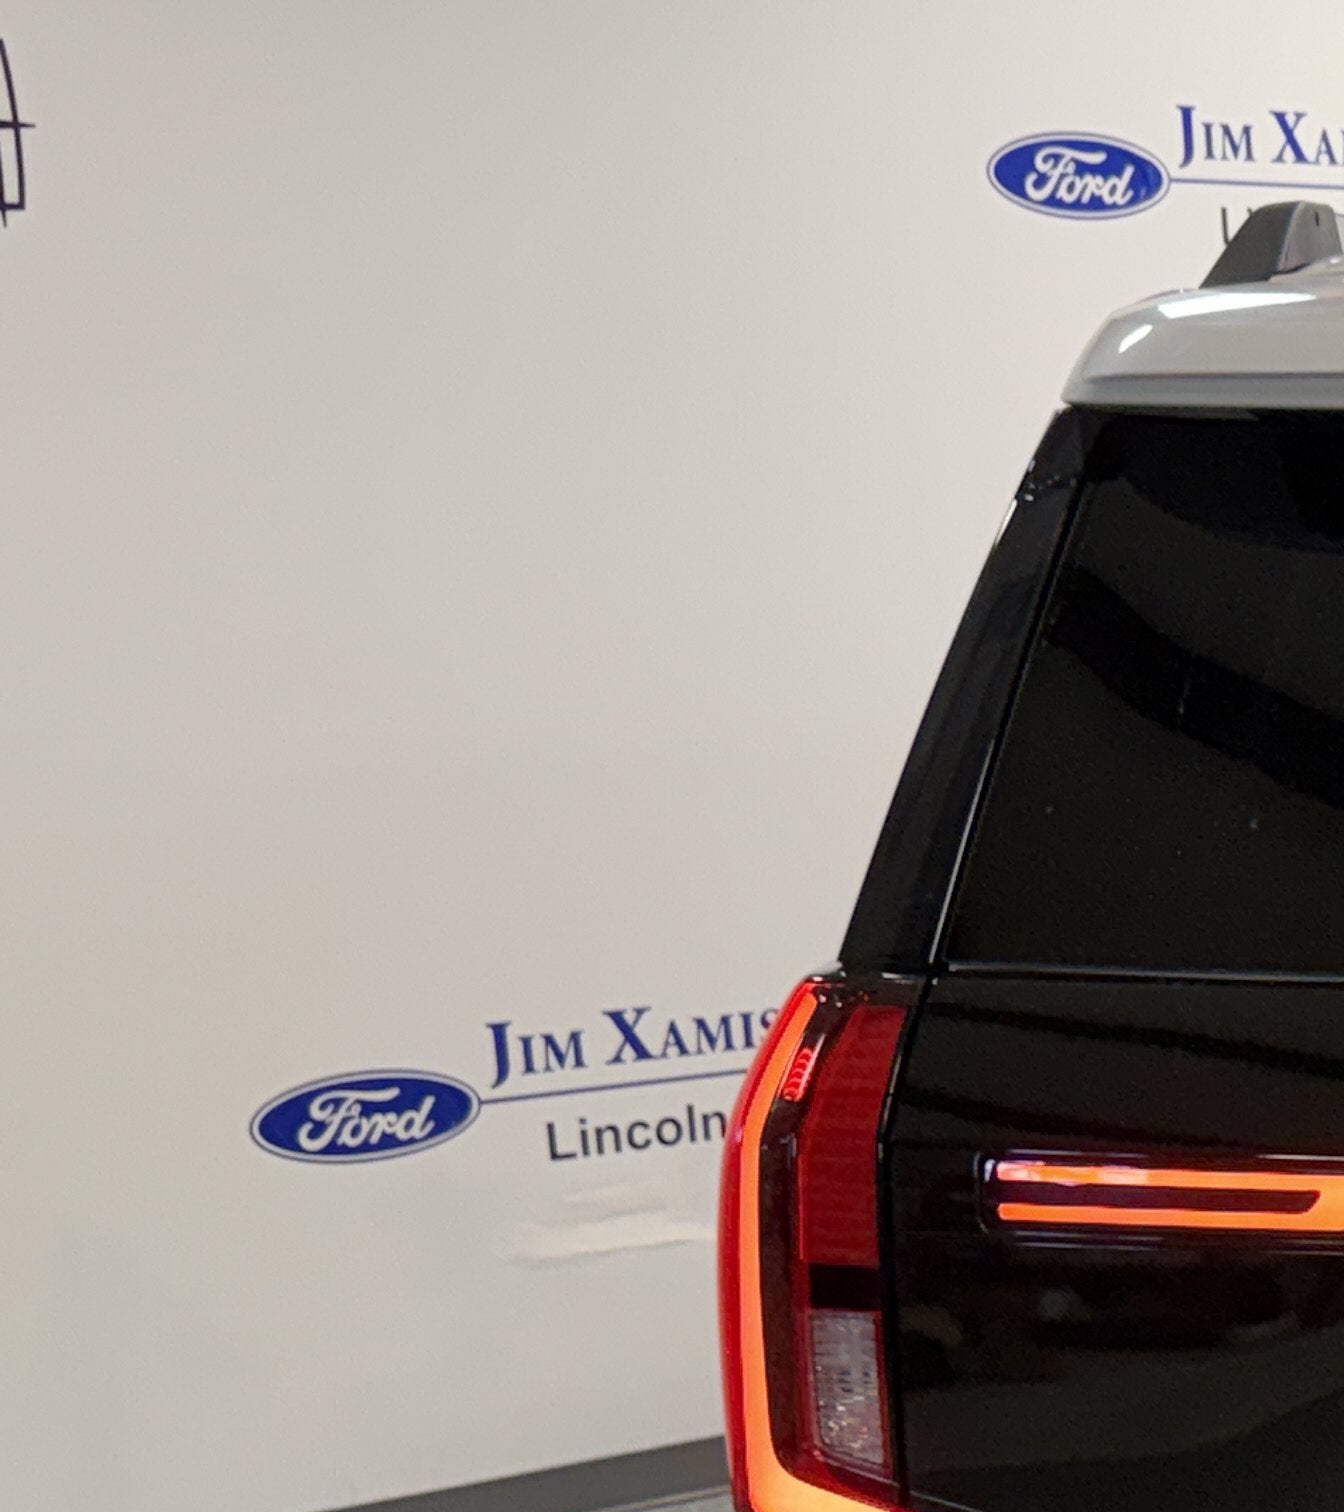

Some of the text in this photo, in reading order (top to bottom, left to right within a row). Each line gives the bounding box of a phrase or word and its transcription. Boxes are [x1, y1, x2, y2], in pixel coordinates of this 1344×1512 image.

[1176, 105, 1254, 169] JIM
[1025, 146, 1133, 207] Ford
[487, 1021, 585, 1089] JIM
[299, 1087, 436, 1152] Ford
